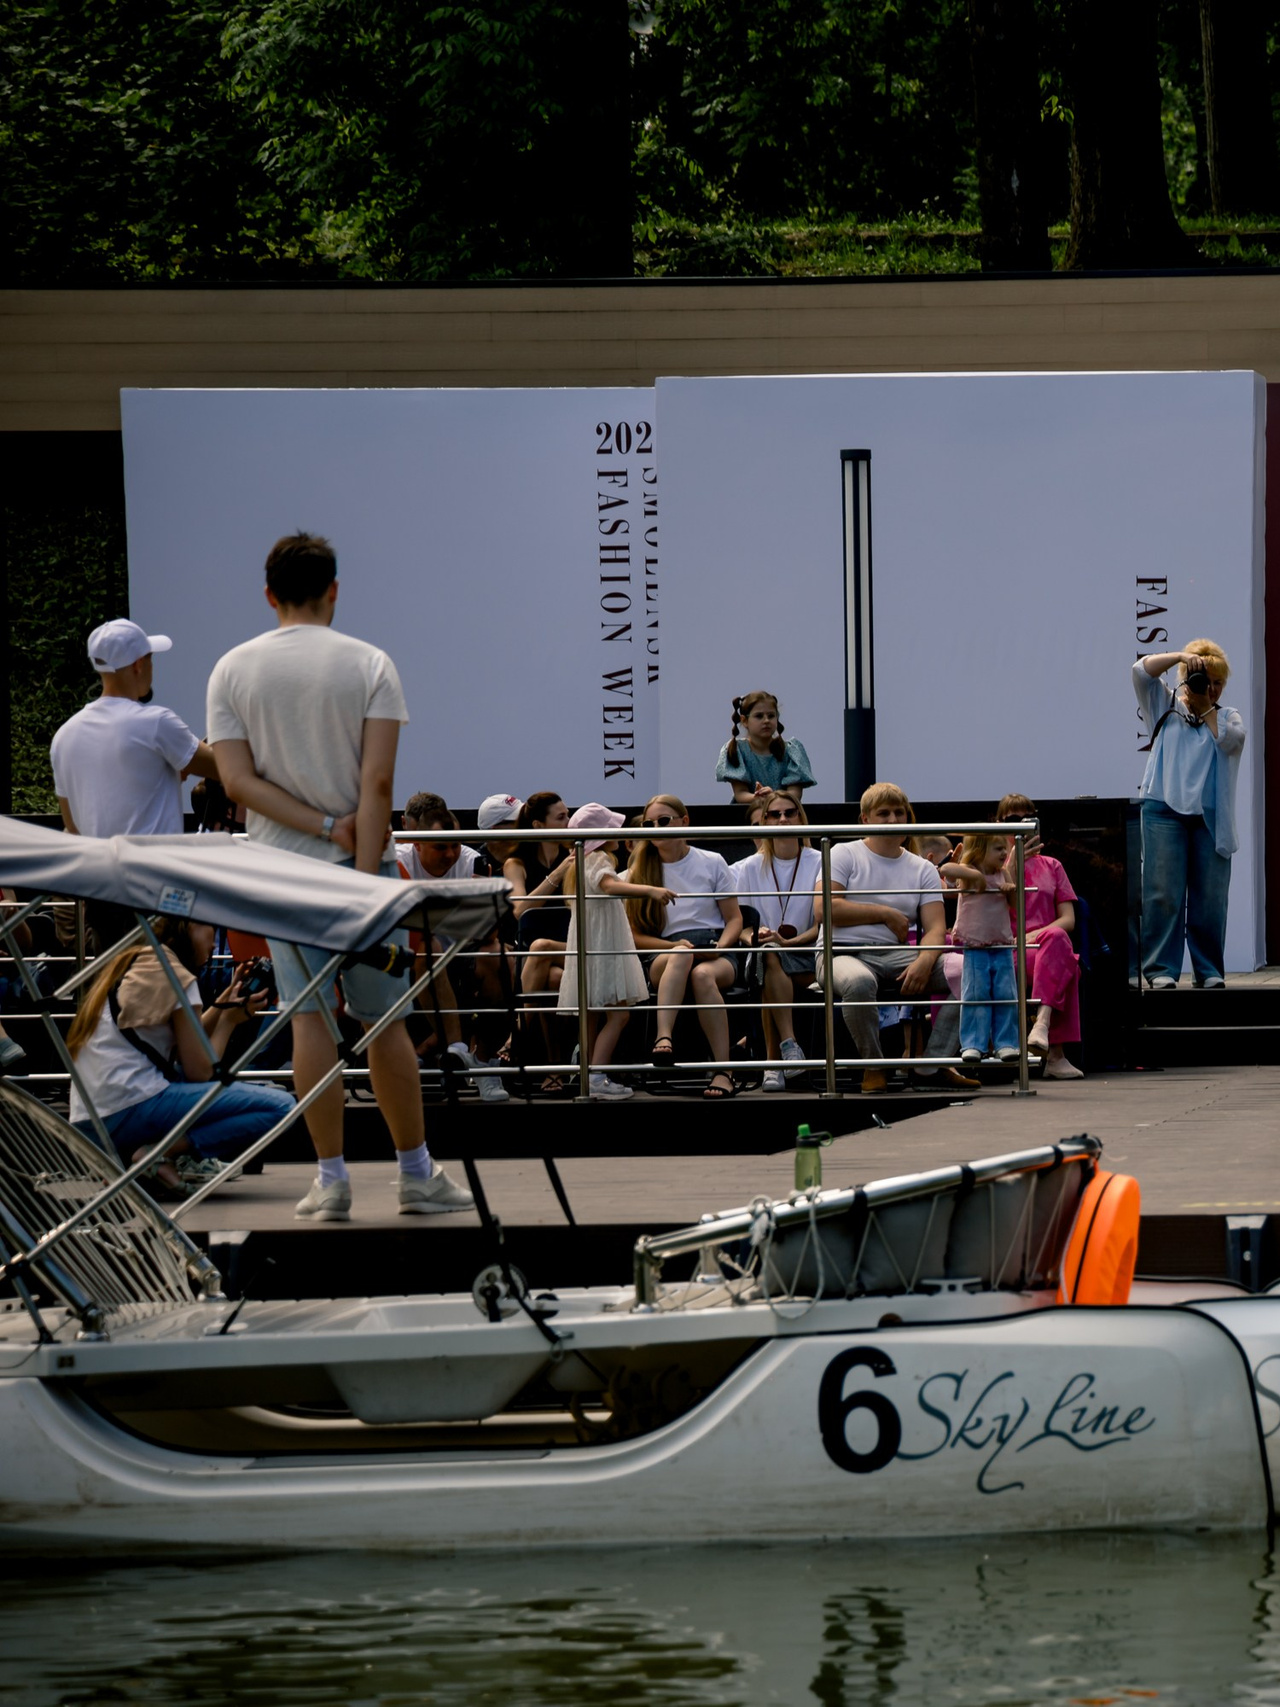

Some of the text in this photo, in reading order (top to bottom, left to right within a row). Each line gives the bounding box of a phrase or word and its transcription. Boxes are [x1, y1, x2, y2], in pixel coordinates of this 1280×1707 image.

[596, 468, 635, 781] FASHION WEEK
[818, 1345, 901, 1474] 6
[896, 1368, 1155, 1494] Sky Line
